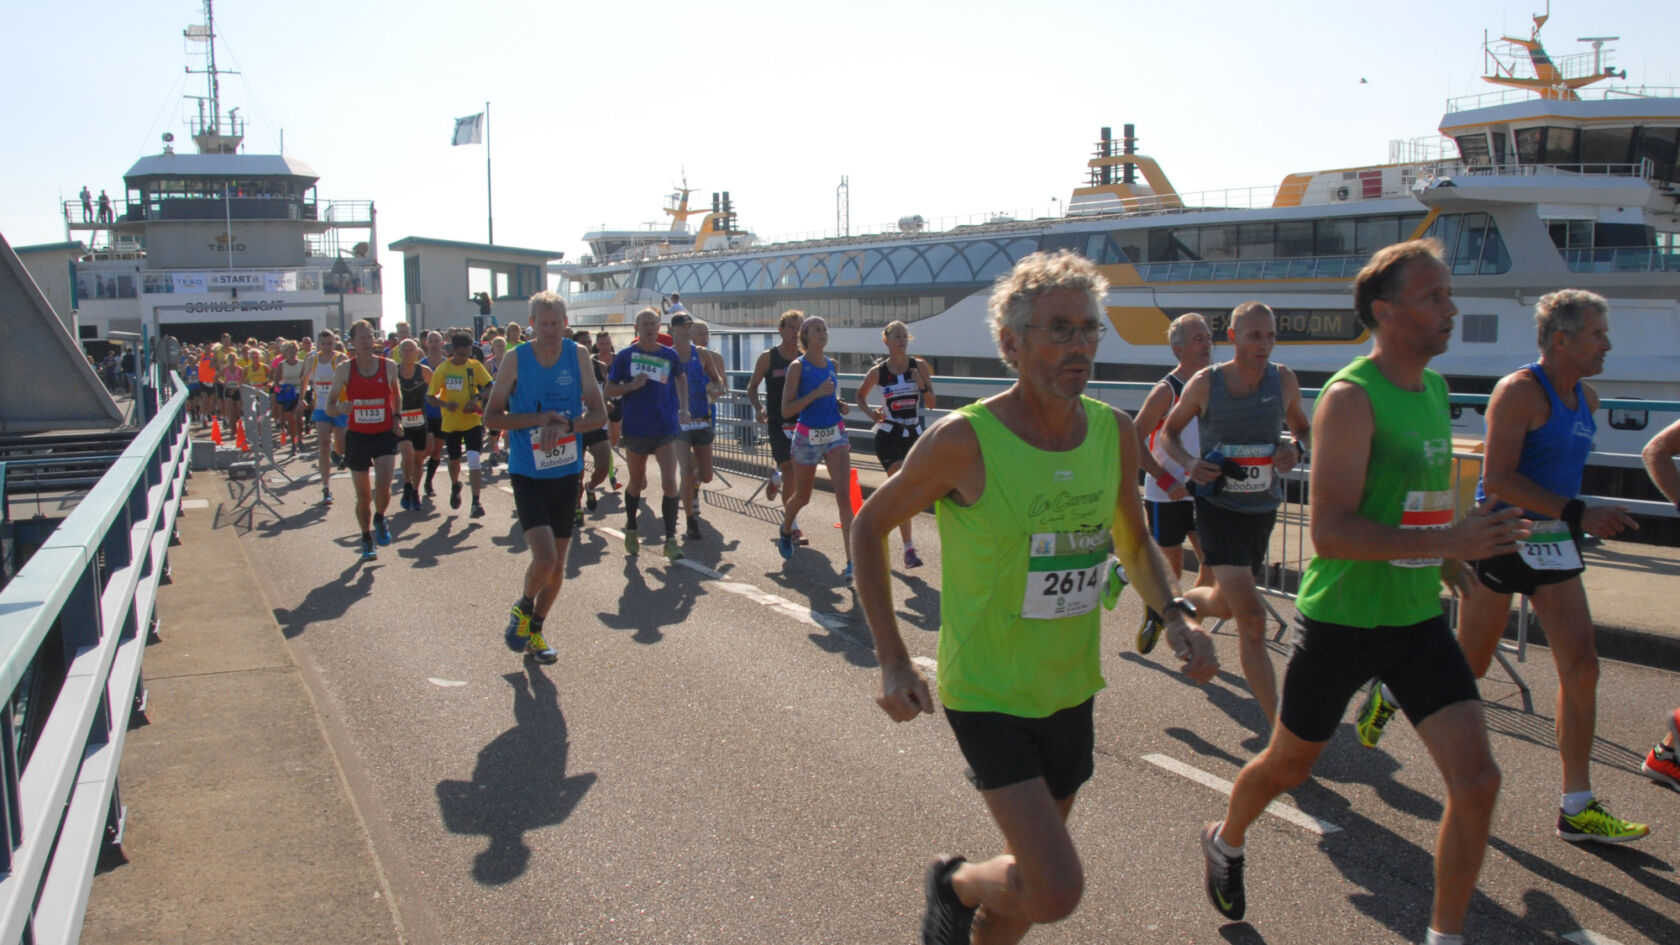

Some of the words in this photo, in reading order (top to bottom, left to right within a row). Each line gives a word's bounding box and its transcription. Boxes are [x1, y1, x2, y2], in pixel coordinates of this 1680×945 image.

[208, 243, 246, 252] TESO
[220, 275, 252, 284] START
[635, 363, 657, 374] 2884
[1043, 568, 1098, 596] 2614
